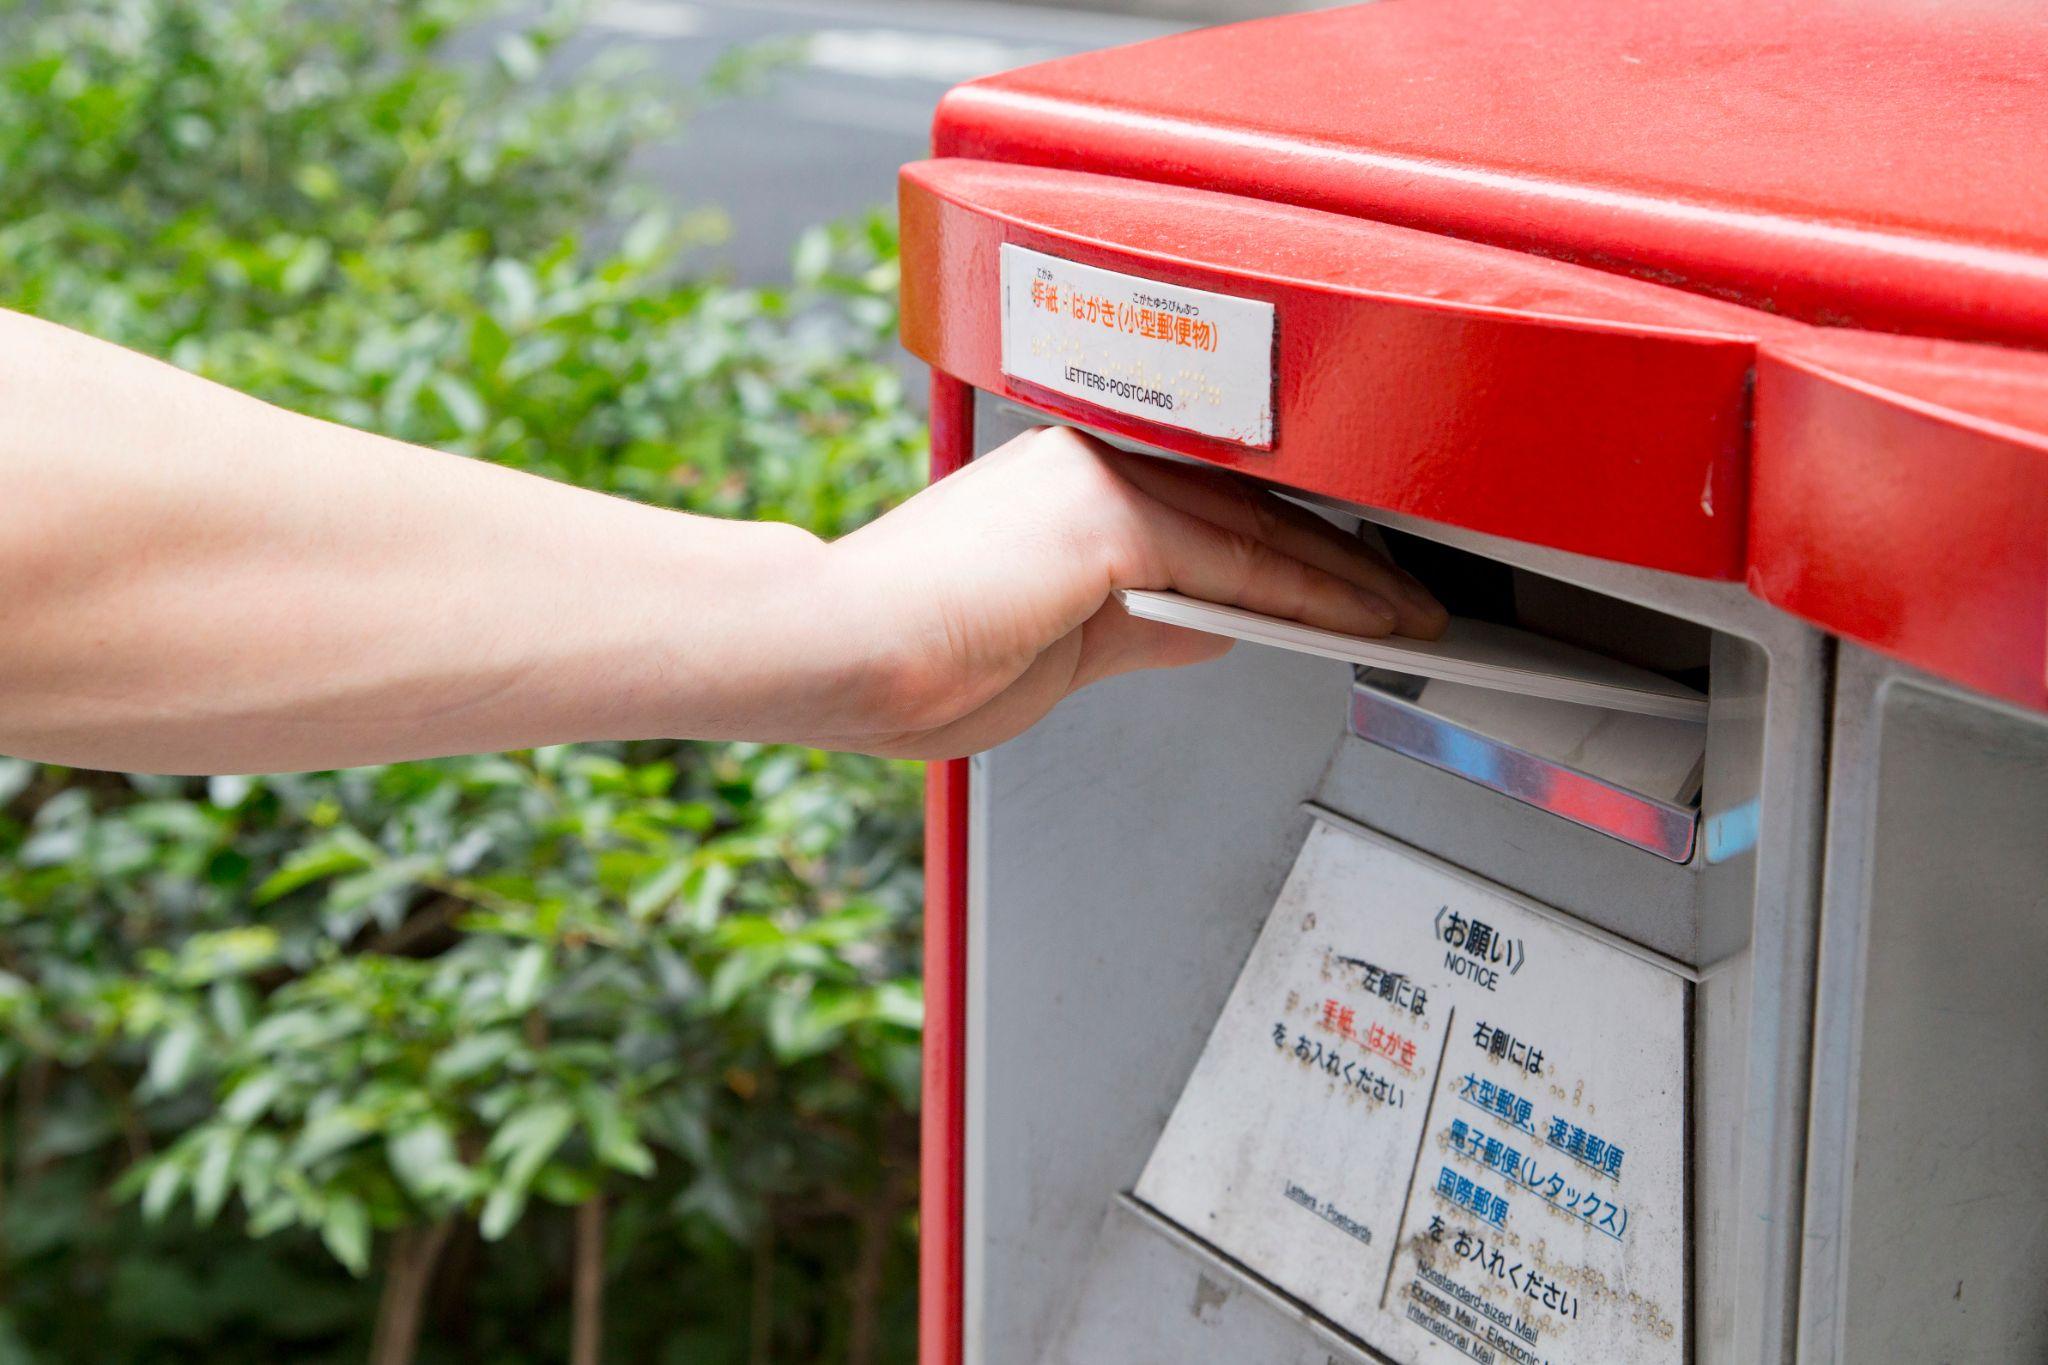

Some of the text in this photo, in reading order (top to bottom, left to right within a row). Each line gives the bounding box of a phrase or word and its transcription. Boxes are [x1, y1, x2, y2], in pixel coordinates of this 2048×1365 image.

[1362, 966, 1428, 1016] 左側には
[1444, 951, 1499, 992] NOTICE
[1473, 1021, 1544, 1074] 右側には
[1437, 1166, 1510, 1228] 国際郵便
[1411, 1280, 1540, 1365] Express Mail Electronic
[1418, 1259, 1539, 1343] Nonstandard-sized Mail
[1407, 1302, 1495, 1365] International Mail
